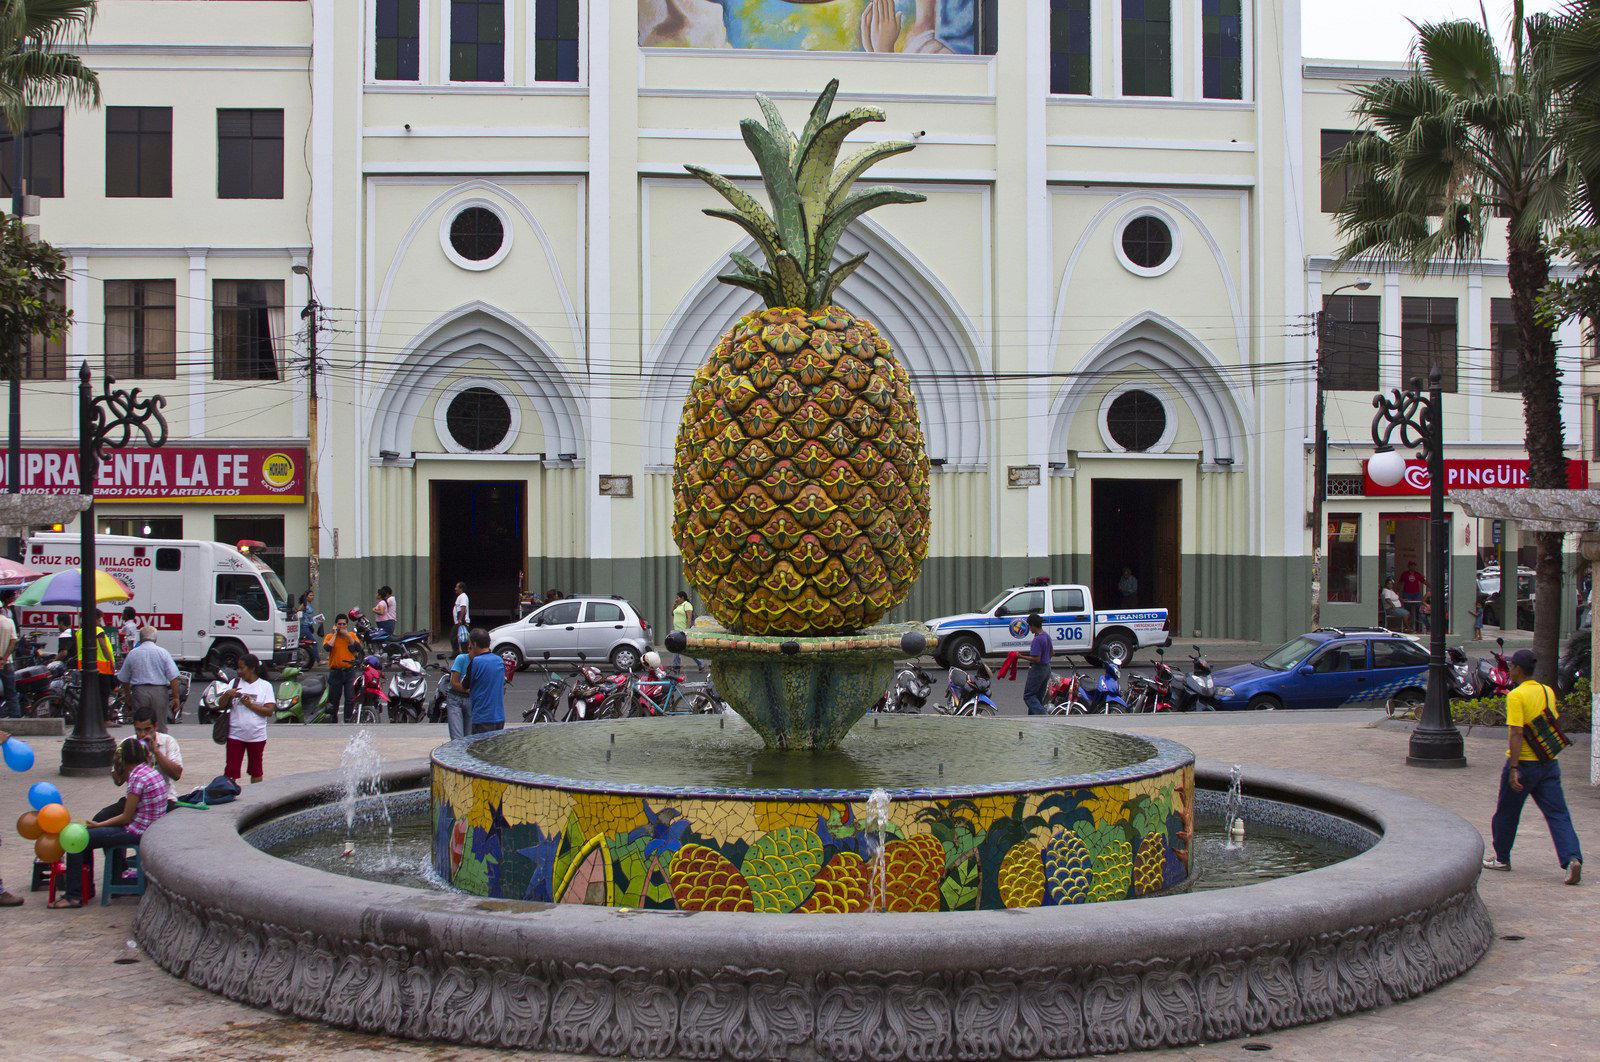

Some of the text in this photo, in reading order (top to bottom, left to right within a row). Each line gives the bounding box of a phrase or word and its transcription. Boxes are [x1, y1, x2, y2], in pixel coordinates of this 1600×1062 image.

[0, 453, 249, 487] PRAENTA LA FE
[125, 488, 158, 496] JOYAS
[161, 488, 169, 496] Y
[169, 488, 241, 496] ARTEFACTOS
[260, 479, 296, 493] EXTENDIDO
[31, 555, 151, 567] CRUZ RO MILAGRO
[1056, 626, 1083, 641] 306
